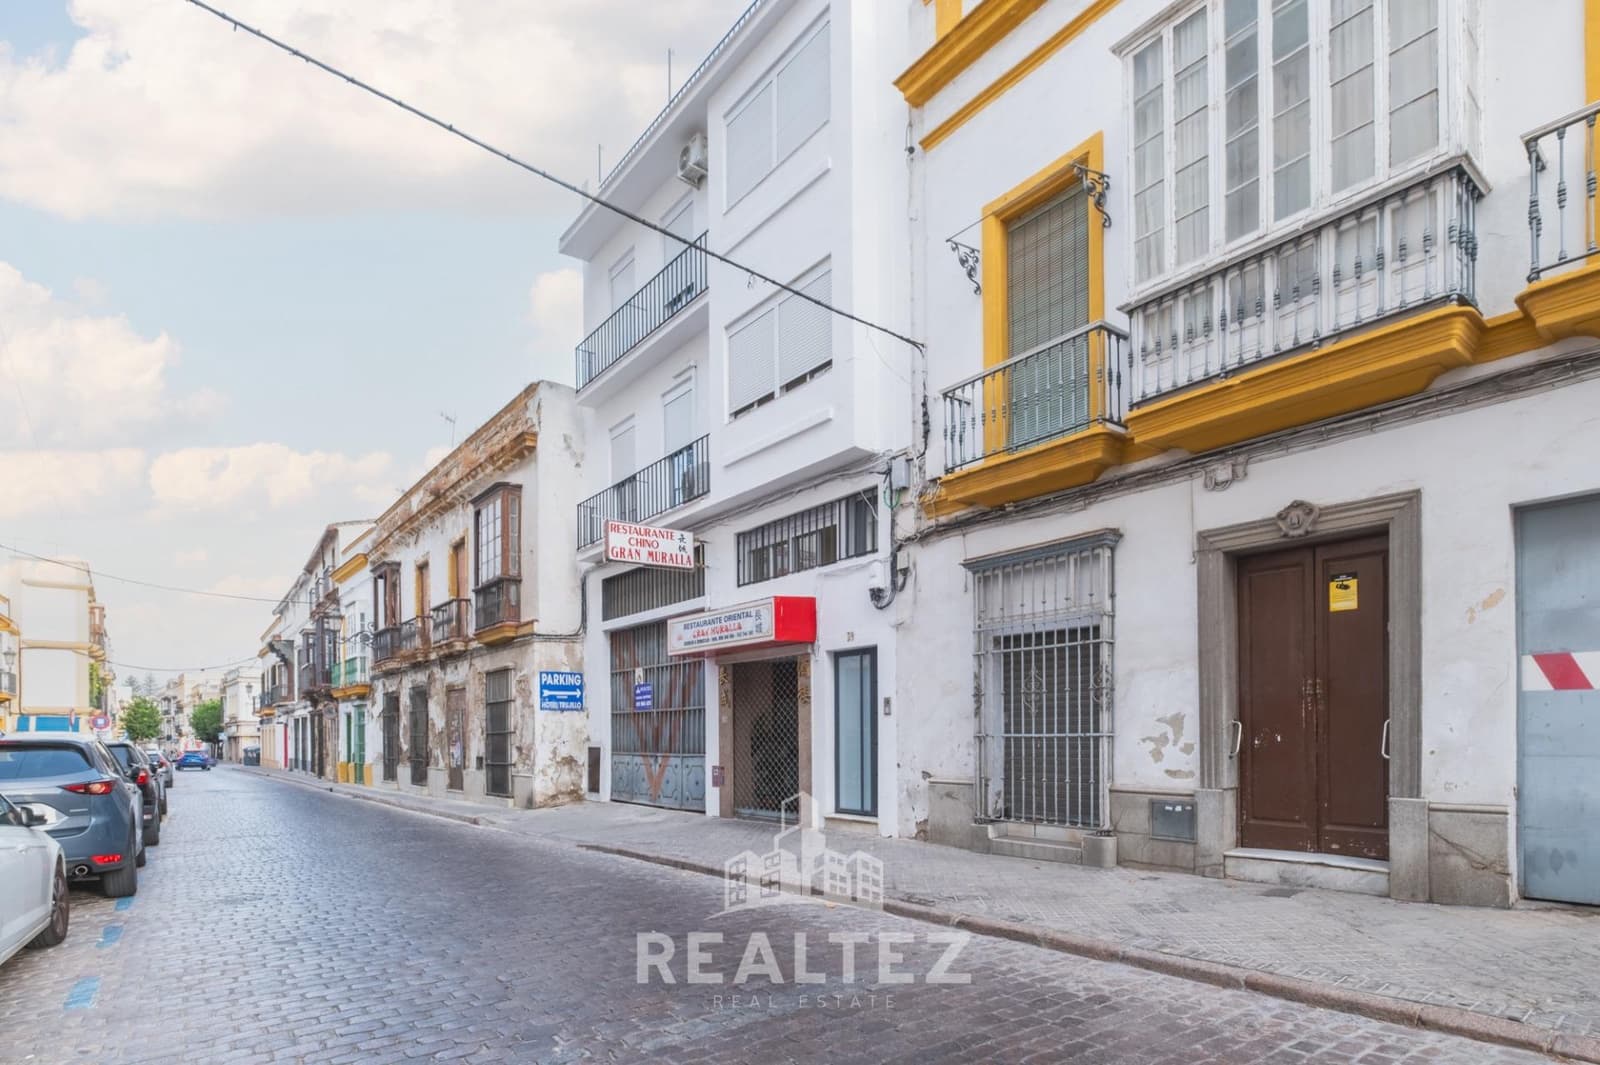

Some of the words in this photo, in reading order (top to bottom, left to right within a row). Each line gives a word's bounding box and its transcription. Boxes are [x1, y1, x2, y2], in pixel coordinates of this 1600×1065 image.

[610, 523, 675, 541] RESTAURANTE
[628, 537, 659, 549] CHINO
[611, 546, 640, 560] GRAN
[647, 550, 692, 566] MURALLA
[683, 615, 722, 630] RESTAURANTE
[723, 610, 753, 624] ORIENTAL
[541, 673, 581, 686] PARKING
